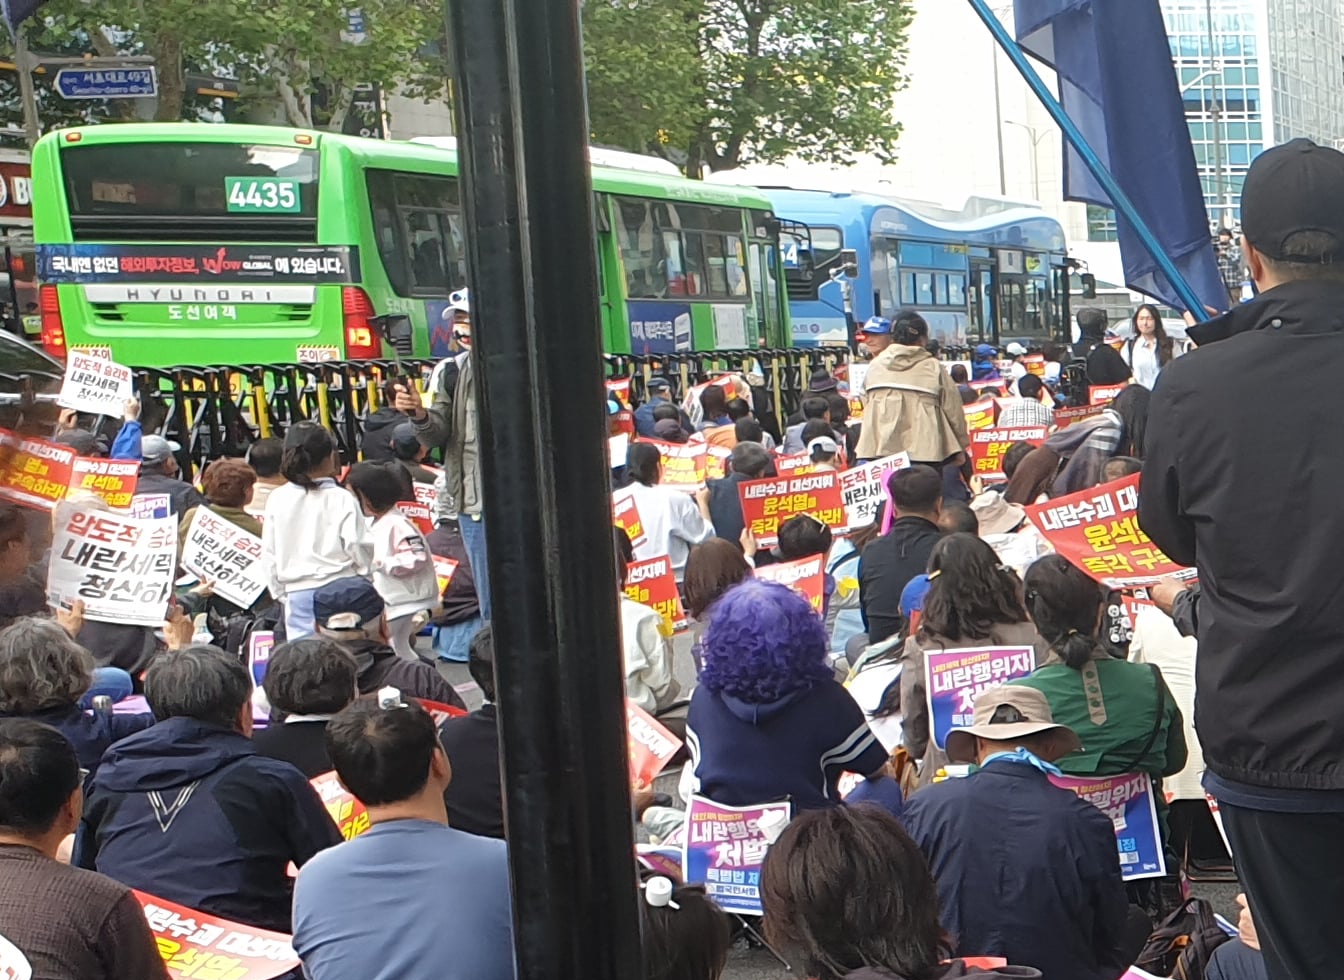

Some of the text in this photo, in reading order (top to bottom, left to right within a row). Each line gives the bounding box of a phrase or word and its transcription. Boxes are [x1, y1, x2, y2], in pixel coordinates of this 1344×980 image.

[229, 182, 296, 208] 4435
[127, 288, 271, 301] HYUNDAI
[168, 304, 237, 320] 도선여객
[744, 482, 787, 499] 내란수괴
[1038, 493, 1116, 531] 내란수괴
[197, 513, 237, 542] 압도적
[60, 539, 171, 577] 내란세력
[191, 529, 254, 570] 내란세력
[628, 560, 667, 584] 선지휘
[78, 573, 168, 605] 청산하
[933, 653, 1030, 693] 내란행위자
[691, 819, 763, 844] 내란행위
[715, 838, 768, 868] 처벌
[706, 869, 745, 884] 특별법
[144, 903, 225, 946] 란수괴
